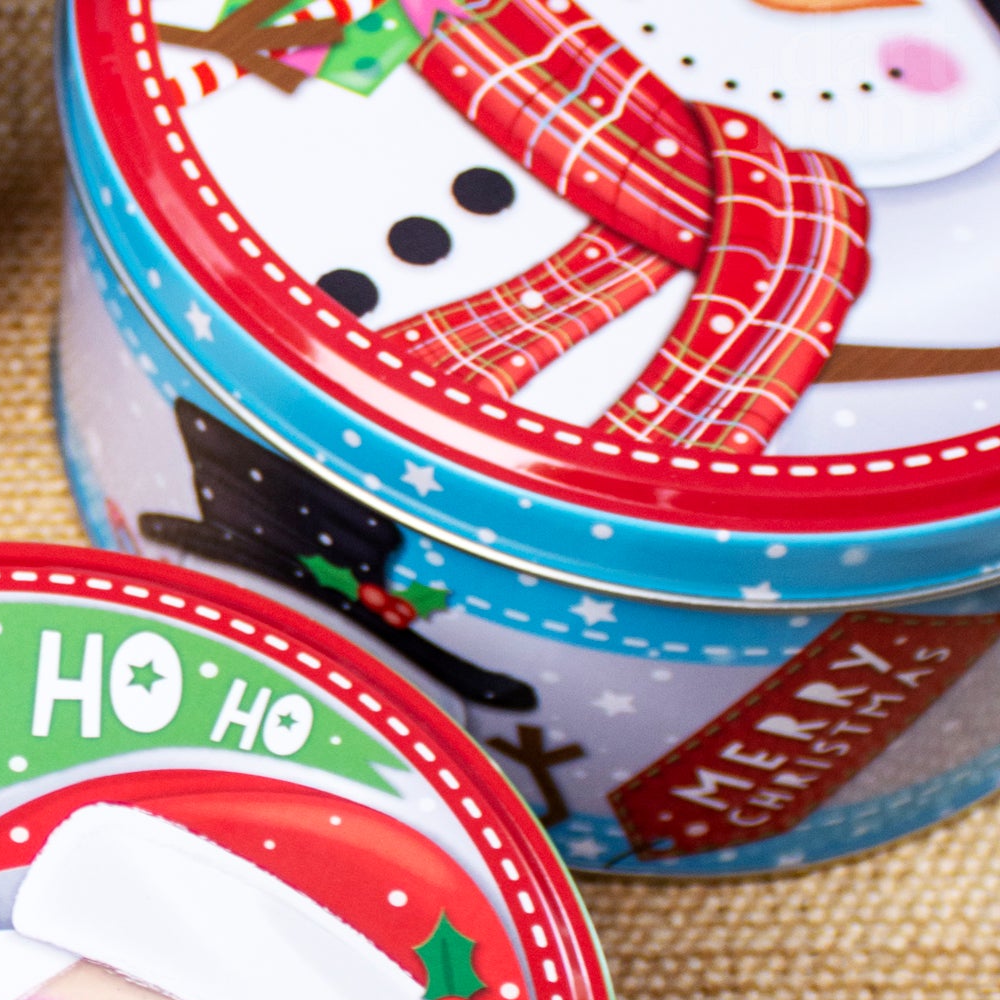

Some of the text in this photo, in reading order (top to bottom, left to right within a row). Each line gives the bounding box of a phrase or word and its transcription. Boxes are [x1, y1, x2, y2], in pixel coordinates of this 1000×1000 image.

[31, 630, 183, 739] HO
[210, 678, 314, 757] HO
[670, 642, 893, 811] MERRY
[727, 646, 952, 828] CHRISTMAS
